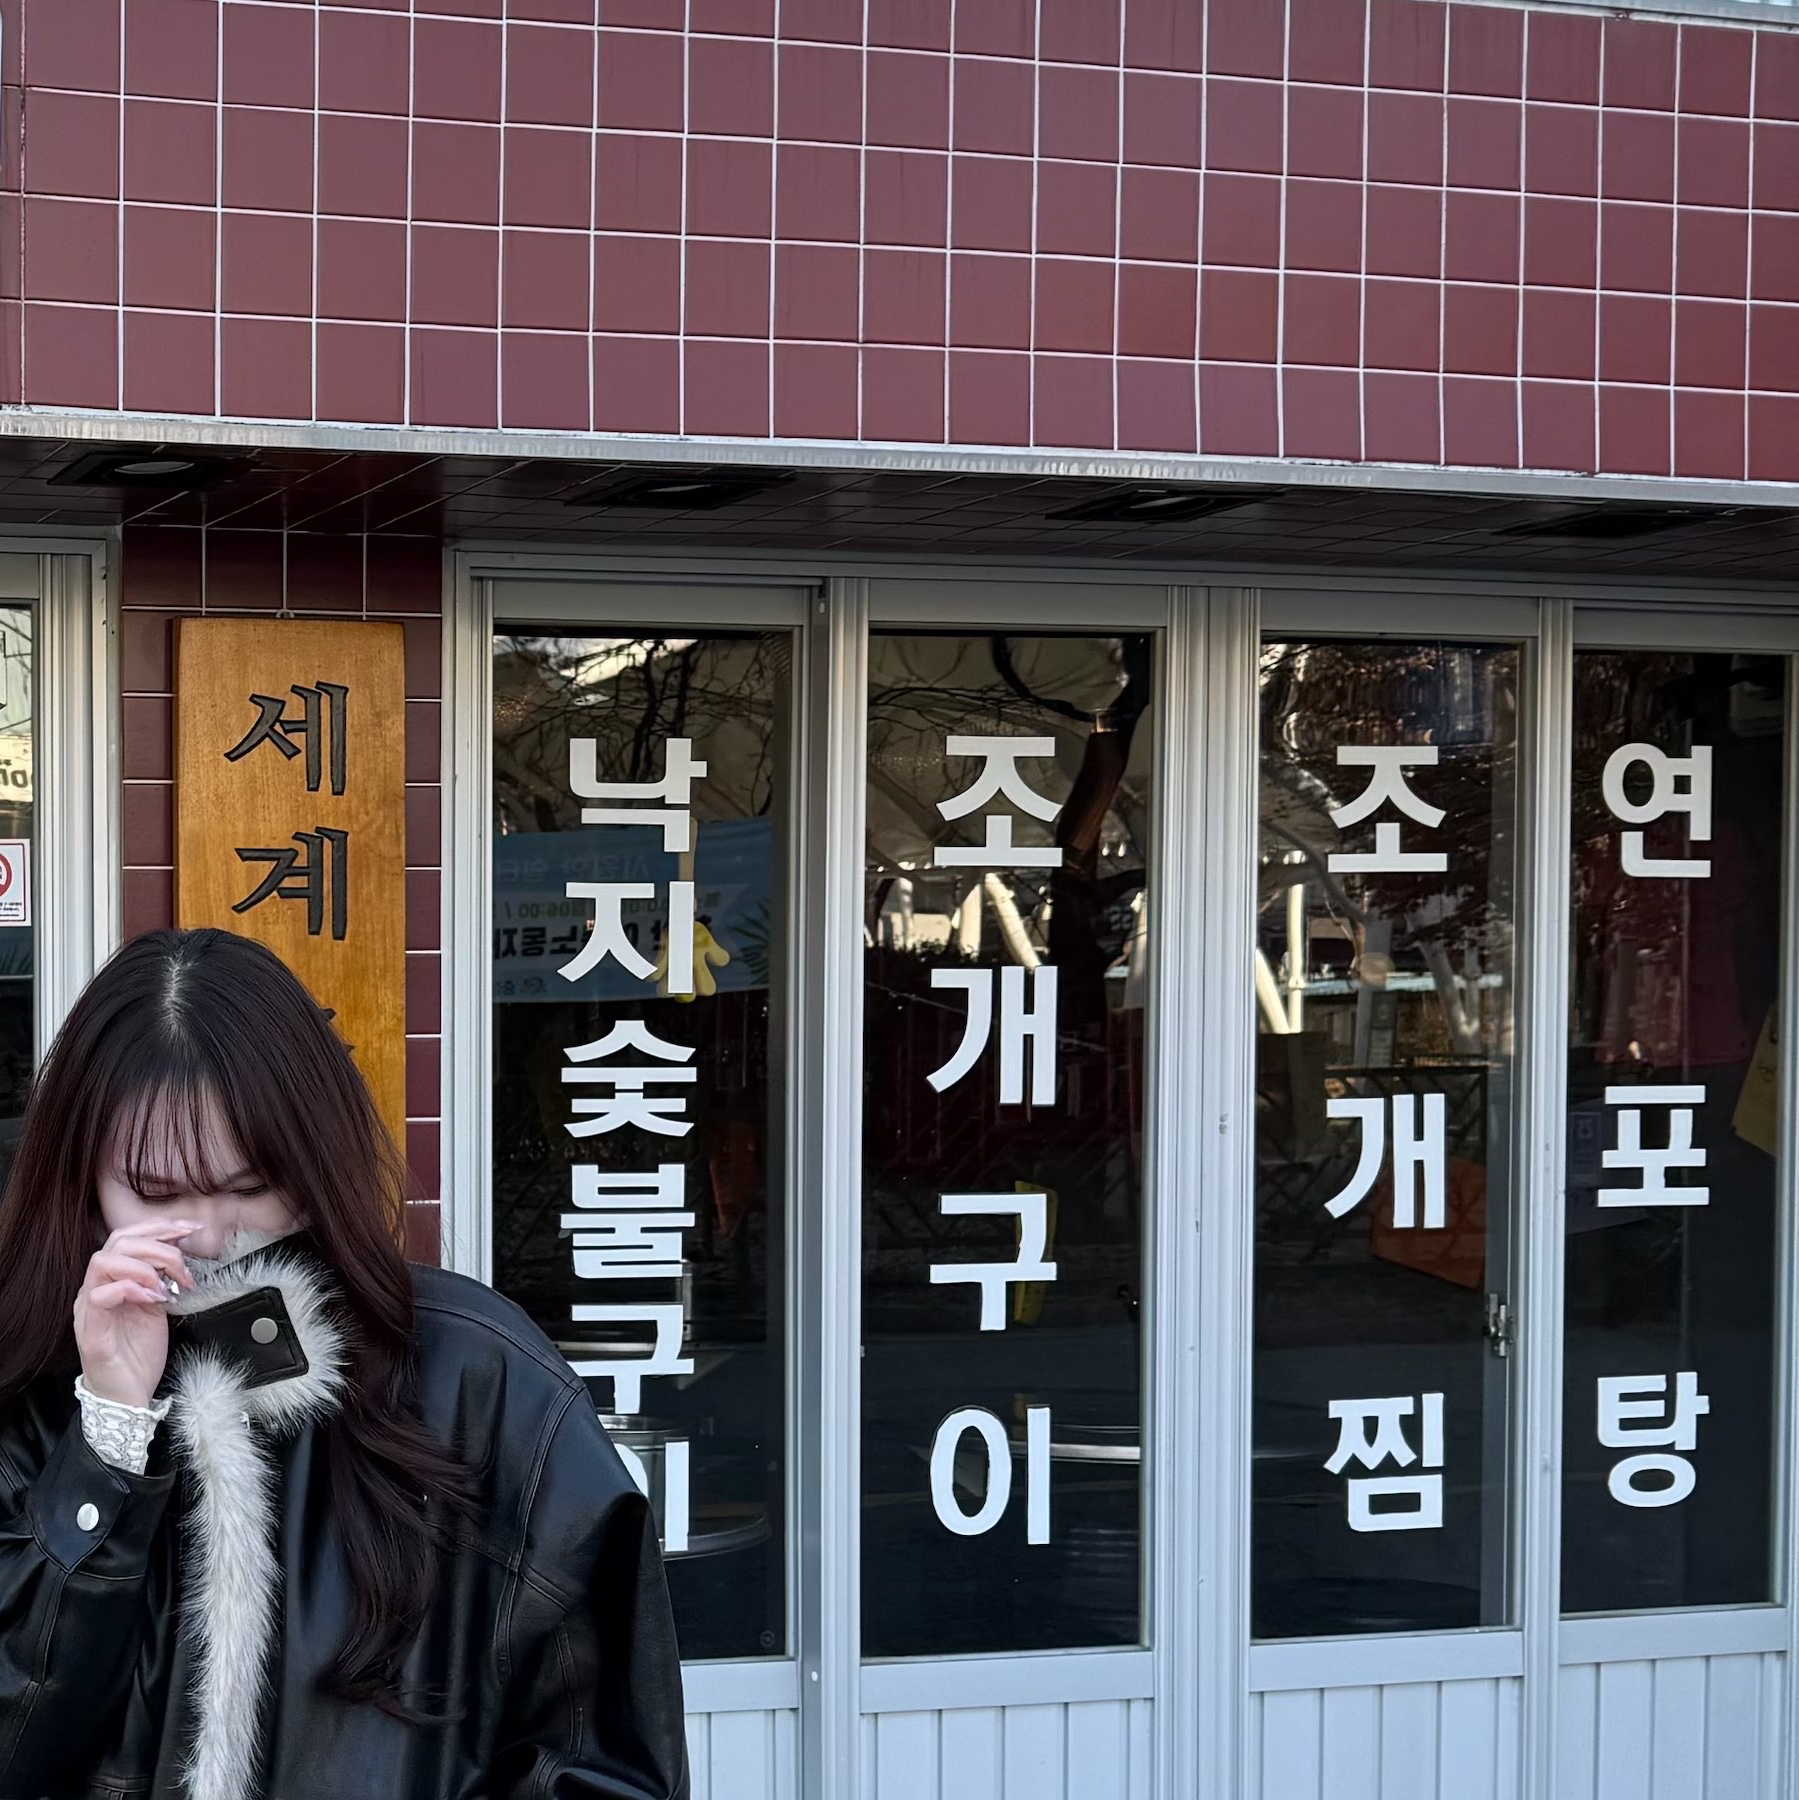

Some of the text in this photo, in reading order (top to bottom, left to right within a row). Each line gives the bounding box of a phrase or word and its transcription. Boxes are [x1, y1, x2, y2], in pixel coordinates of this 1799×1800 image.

[223, 680, 354, 1053] 세계
[926, 735, 1063, 1546] 조개구이
[1323, 744, 1448, 1533] 조개찜
[1594, 742, 1713, 1509] 연포탕
